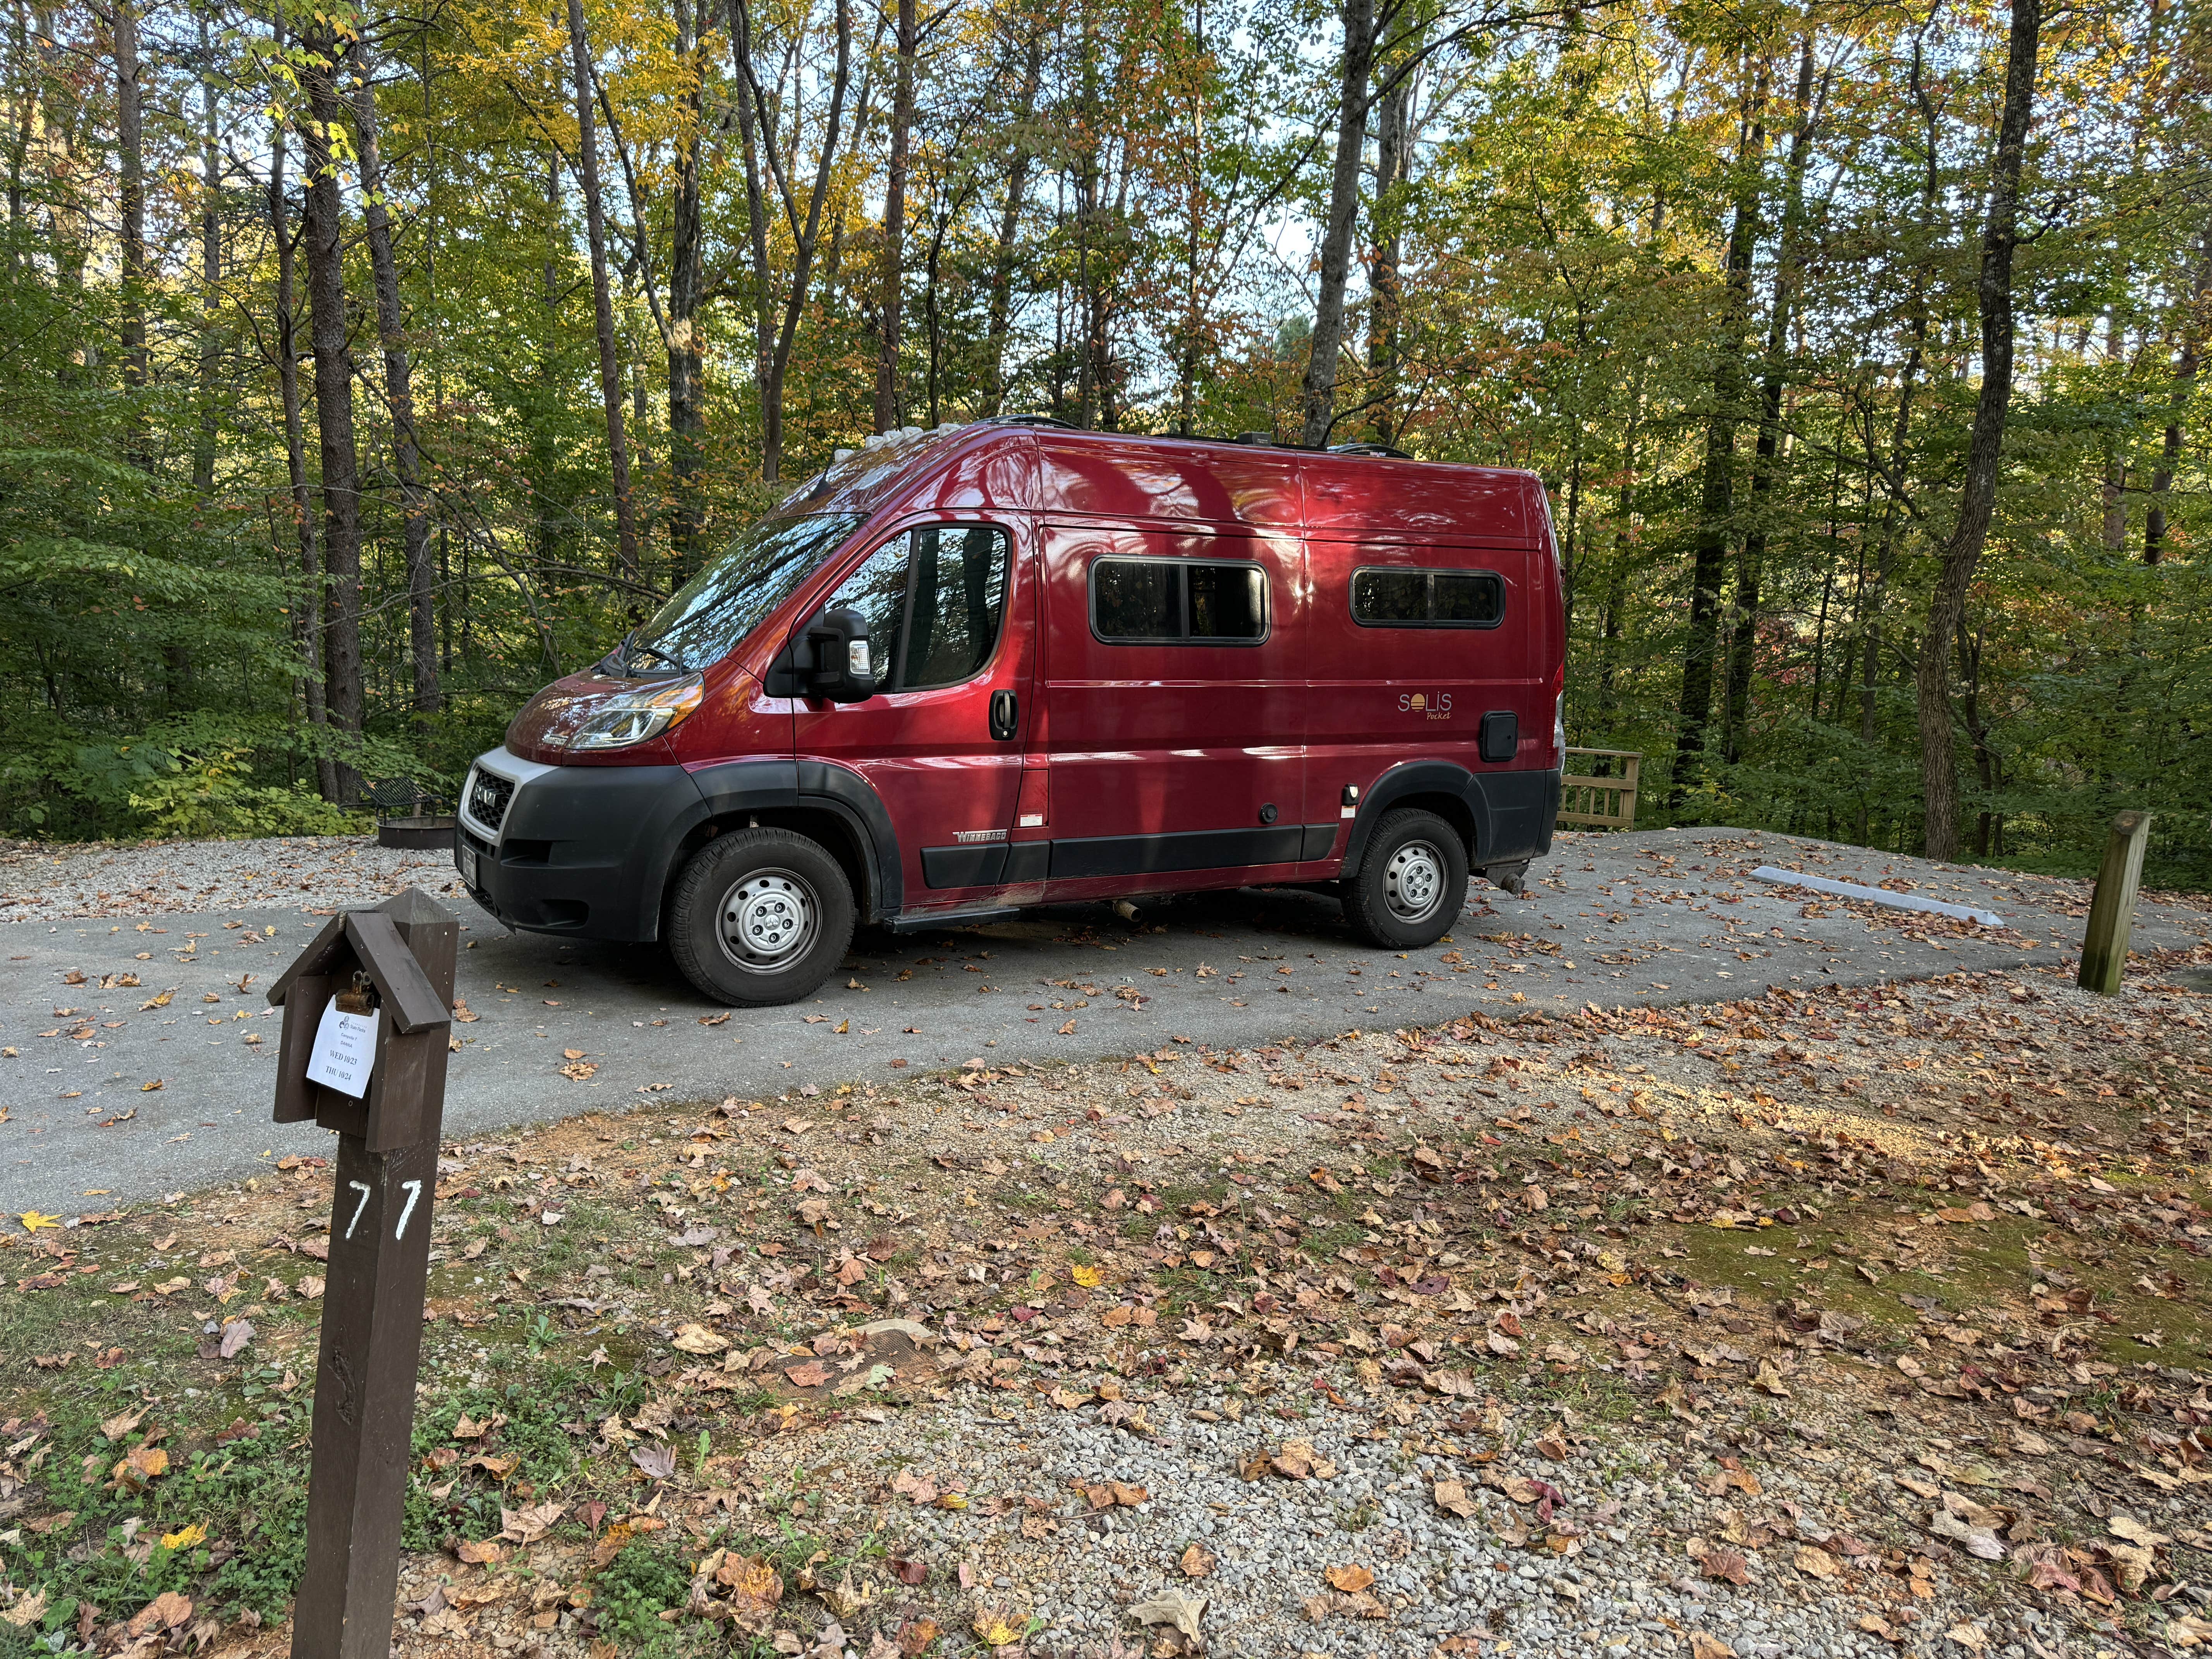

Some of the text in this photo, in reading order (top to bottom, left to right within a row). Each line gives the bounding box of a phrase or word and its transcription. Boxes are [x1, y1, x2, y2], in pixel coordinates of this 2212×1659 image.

[1427, 711, 1451, 720] Pocket
[952, 829, 1008, 843] WINNEBAGO
[330, 1050, 357, 1065] WED 10/23
[326, 1065, 352, 1081] THU 10/24
[345, 1180, 371, 1239] 7
[395, 1180, 422, 1240] 7
